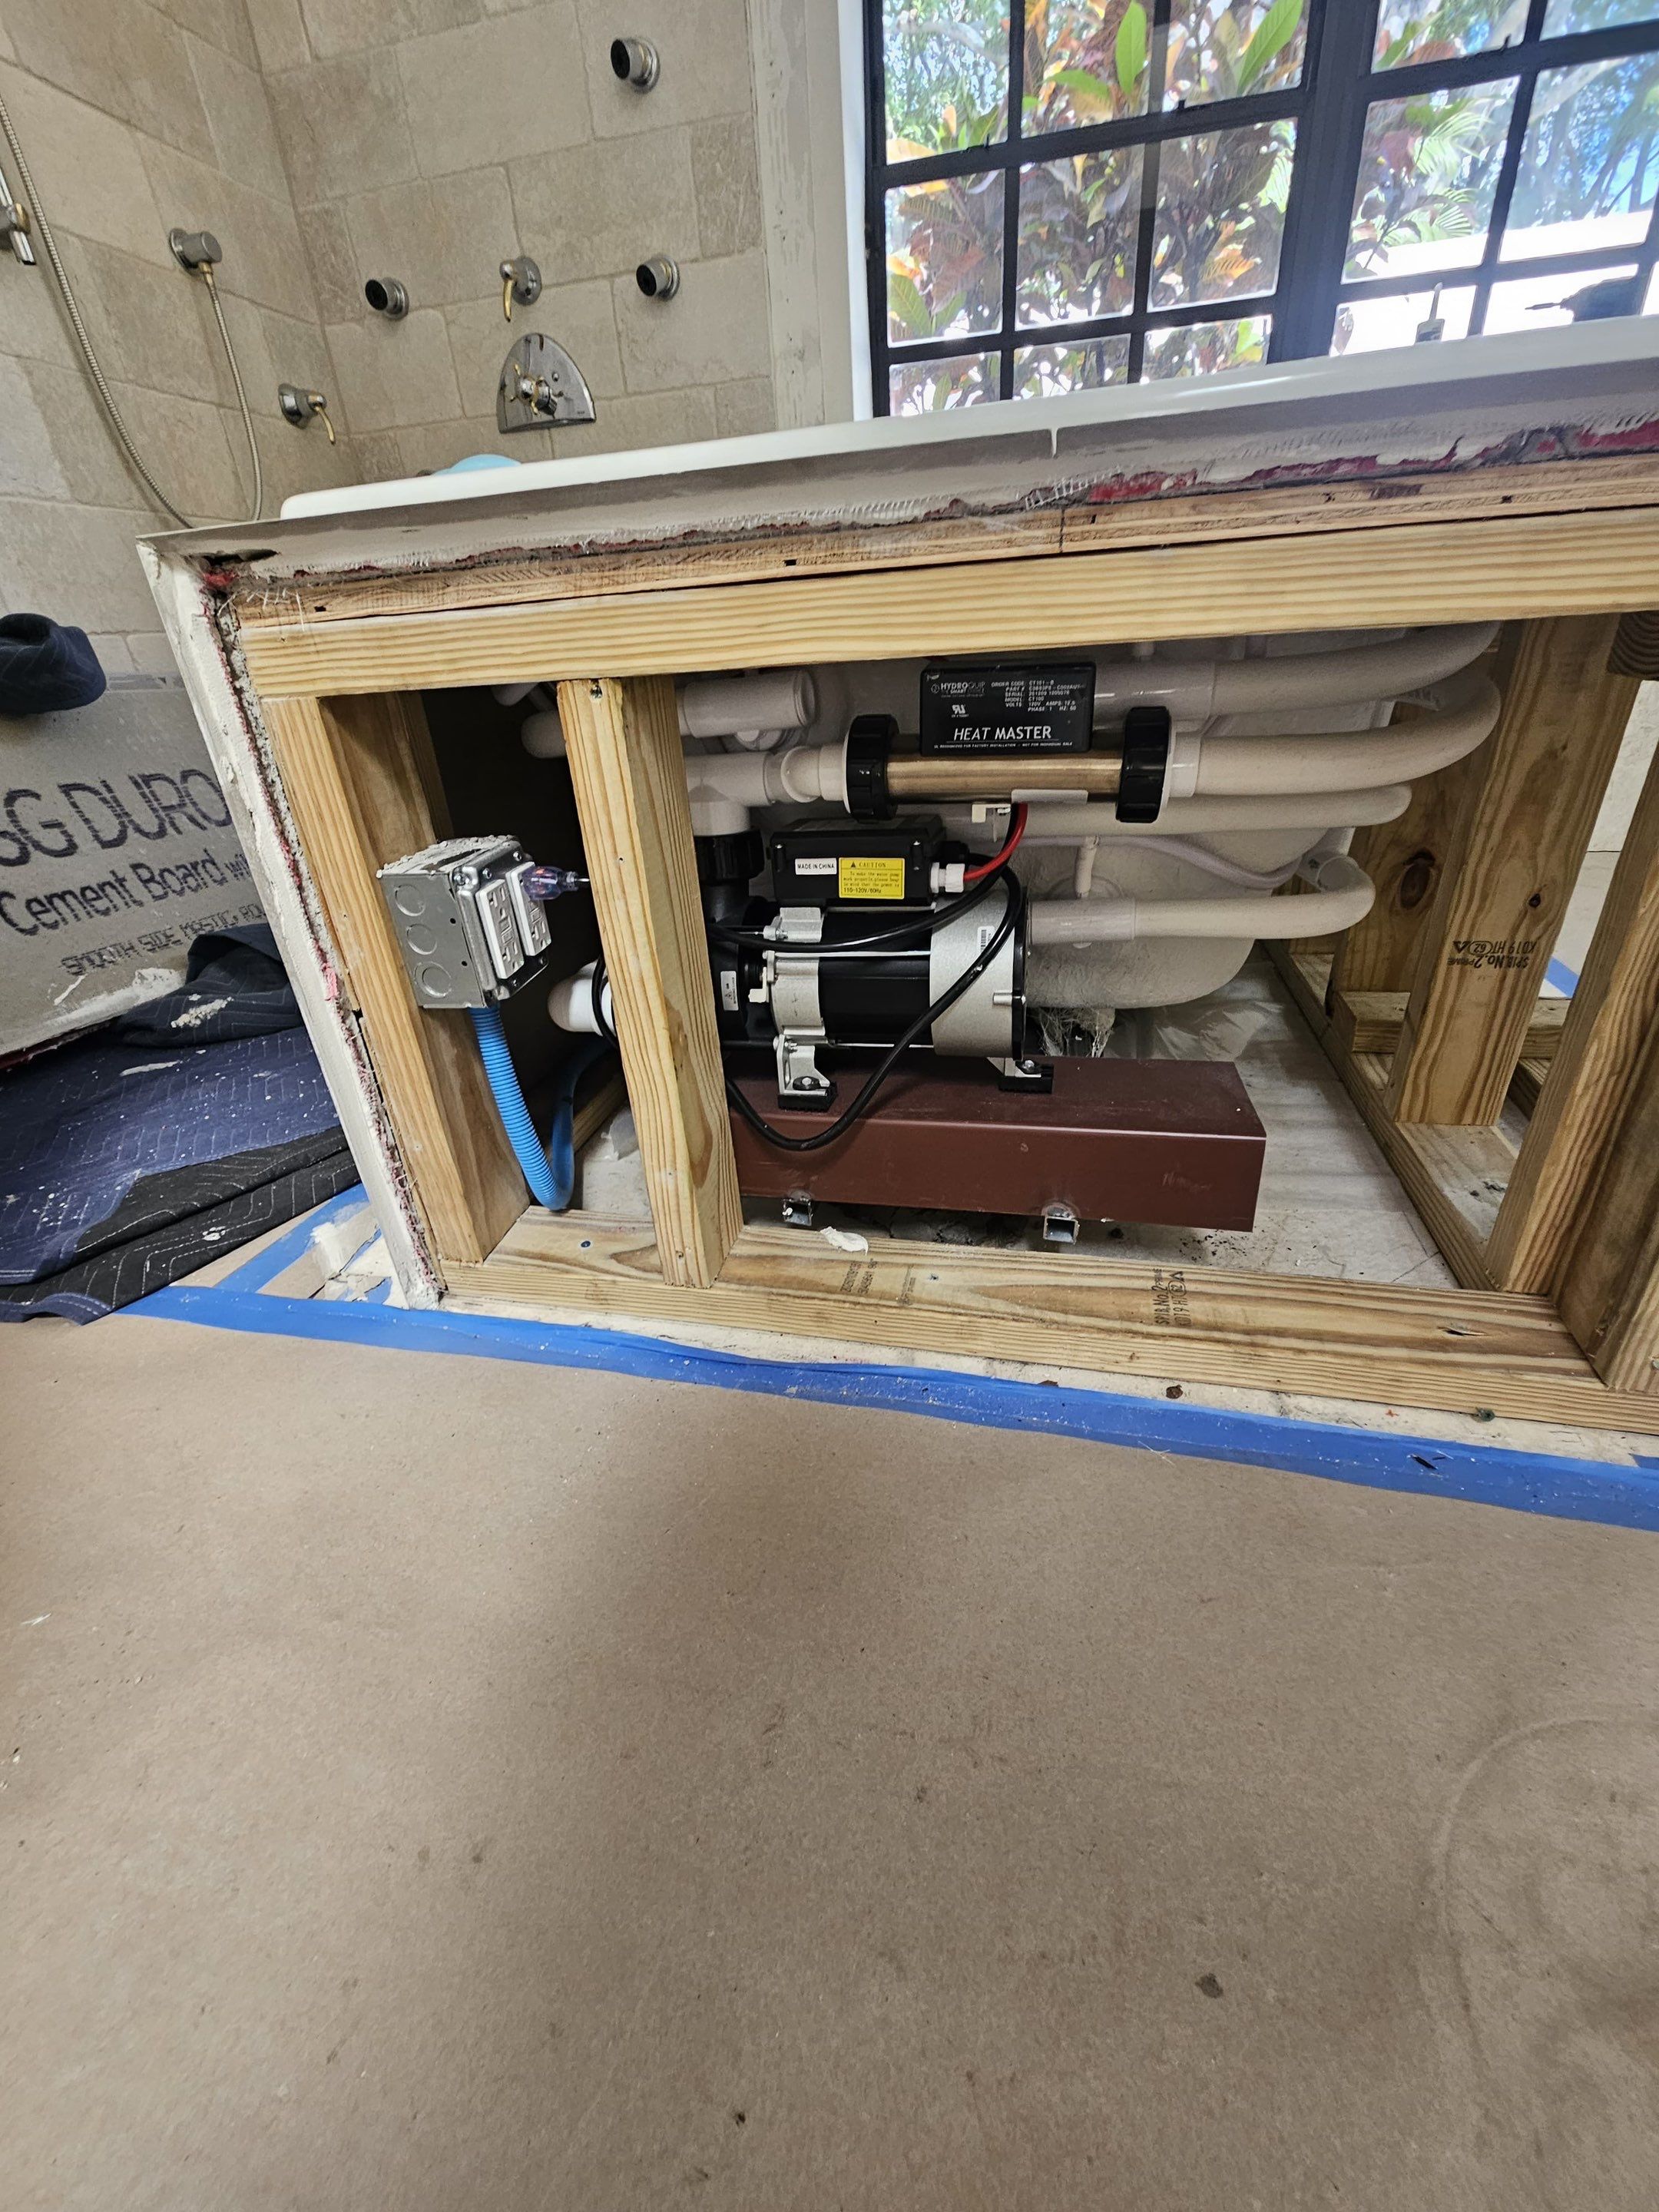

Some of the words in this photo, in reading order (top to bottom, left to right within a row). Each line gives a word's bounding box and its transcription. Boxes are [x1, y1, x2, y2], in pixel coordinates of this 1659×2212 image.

[941, 681, 985, 690] HYDROQUIP
[953, 727, 991, 741] HEAT
[995, 726, 1052, 740] MASTER
[0, 869, 144, 936] Cement
[129, 847, 228, 901] Board
[137, 928, 184, 952] SIDE
[1491, 940, 1506, 954] HT
[1474, 943, 1487, 952] 62
